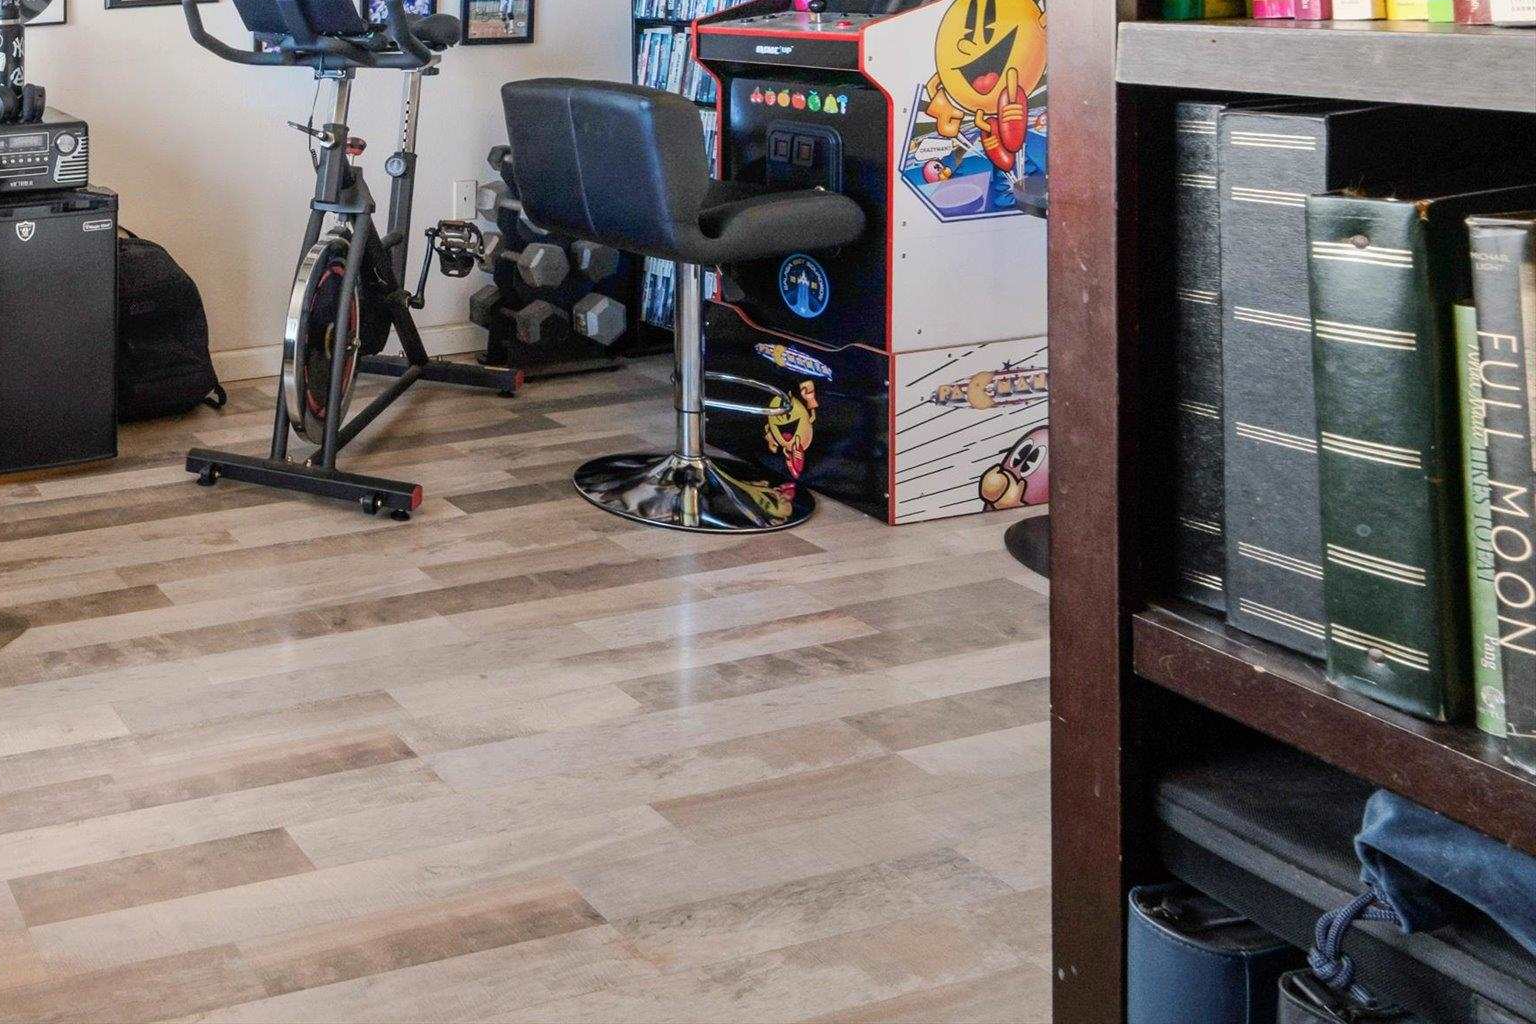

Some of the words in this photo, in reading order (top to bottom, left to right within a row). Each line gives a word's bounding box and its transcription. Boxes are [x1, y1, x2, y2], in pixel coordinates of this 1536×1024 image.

[1477, 329, 1525, 450] FULL
[1483, 478, 1536, 656] MOON
[1480, 634, 1502, 672] Pang
